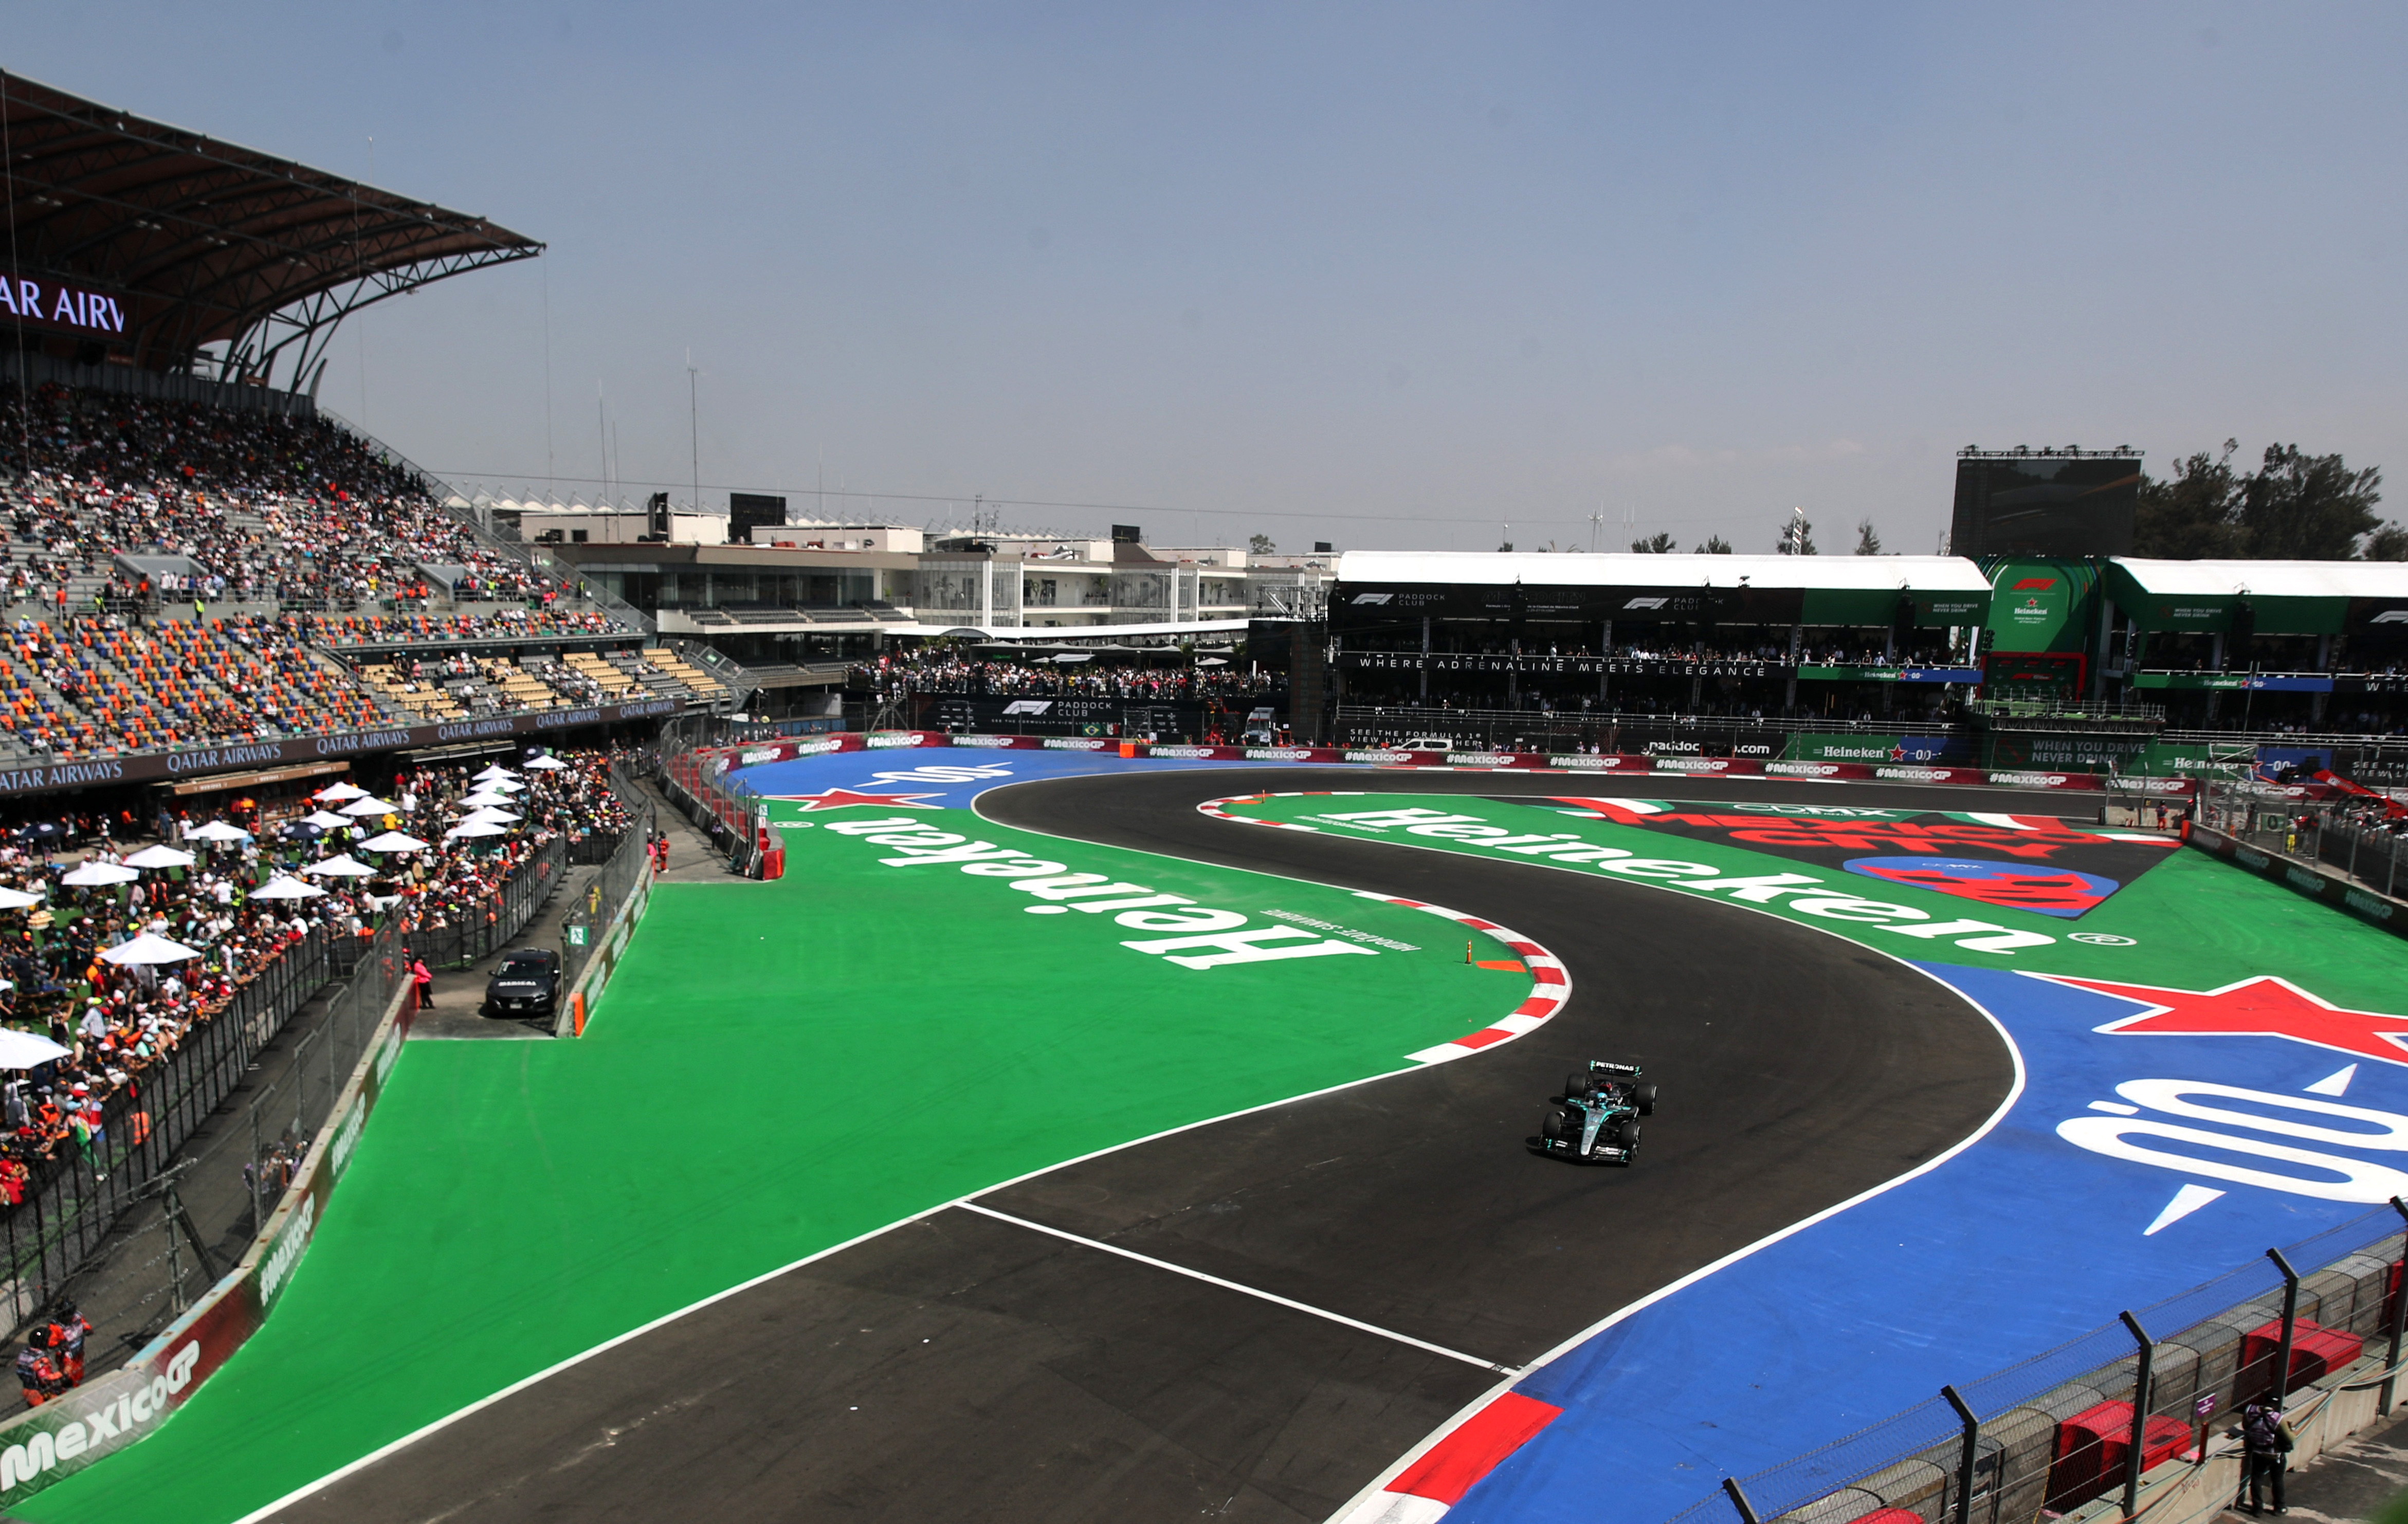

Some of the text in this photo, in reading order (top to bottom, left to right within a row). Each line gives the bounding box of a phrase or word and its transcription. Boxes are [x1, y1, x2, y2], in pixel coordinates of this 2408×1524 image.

[1360, 659, 1764, 677] WHERE ADRENALINE MEETS ELEGANCE
[619, 700, 675, 718] QATAR AIRWAYS
[1058, 709, 1088, 717] CLUB
[536, 710, 600, 729] QATAR AIRWAYS
[438, 719, 514, 740] QATAR AIRWAYS
[1406, 731, 1462, 739] FORMULA
[317, 729, 410, 754] QATAR AIRWAYS
[798, 739, 843, 755] #MexicoGP
[868, 736, 924, 748] #MexicoGP
[953, 736, 1014, 747] #MexicoGP
[1044, 738, 1105, 749] #MexicoGP
[2033, 740, 2146, 753] WHEN YOU DRIVE
[167, 743, 282, 773] QATAR AIRWAYS
[1150, 747, 1214, 757] #MexicoGP
[1246, 749, 1311, 760] #MexicoGP
[1345, 752, 1412, 763] #MexicoGP
[2032, 752, 2073, 763] NEVER
[1447, 754, 1516, 765] #MexicoGP
[1550, 756, 1621, 767] #MexicoGP
[1656, 759, 1728, 770] #MexicoGP
[48, 761, 123, 786] AIRWAYS
[1765, 763, 1839, 775] #MexicoGP
[1875, 767, 1951, 781] #MexicoGP
[1989, 773, 2067, 786] #MexicoGP
[1734, 804, 1898, 818] CDMX
[1601, 812, 2113, 845] MEXICO
[1729, 829, 2068, 859] CITY
[1317, 807, 2056, 955] Heineken
[824, 818, 1381, 970] Heineken
[1596, 1061, 1634, 1072] PETRONAS
[260, 1192, 315, 1307] #MexicoGP
